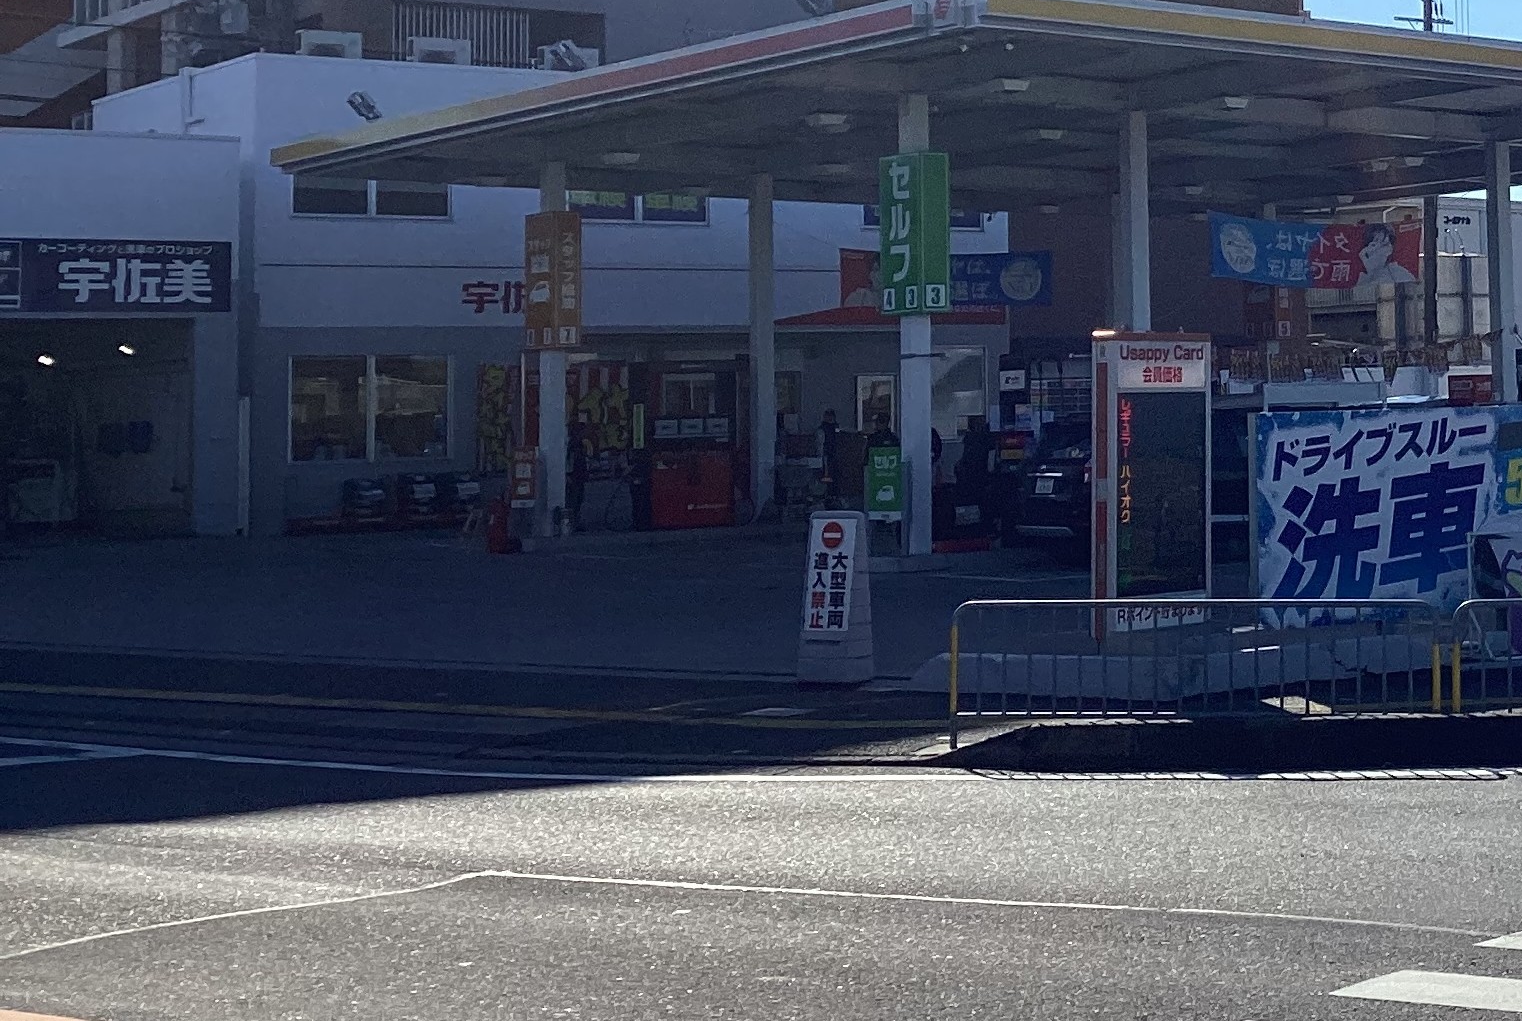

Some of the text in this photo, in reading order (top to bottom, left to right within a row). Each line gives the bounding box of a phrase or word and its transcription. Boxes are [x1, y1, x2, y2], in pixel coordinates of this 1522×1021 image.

[888, 162, 910, 283] セルフ
[57, 258, 213, 304] 宇佐美
[1119, 343, 1170, 363] Usappy
[1173, 344, 1204, 361] Card
[1273, 416, 1488, 482] ドライブスルー
[1271, 460, 1486, 600] 洗車
[808, 552, 829, 629] 進入禁止
[826, 552, 849, 629] 大型車両
